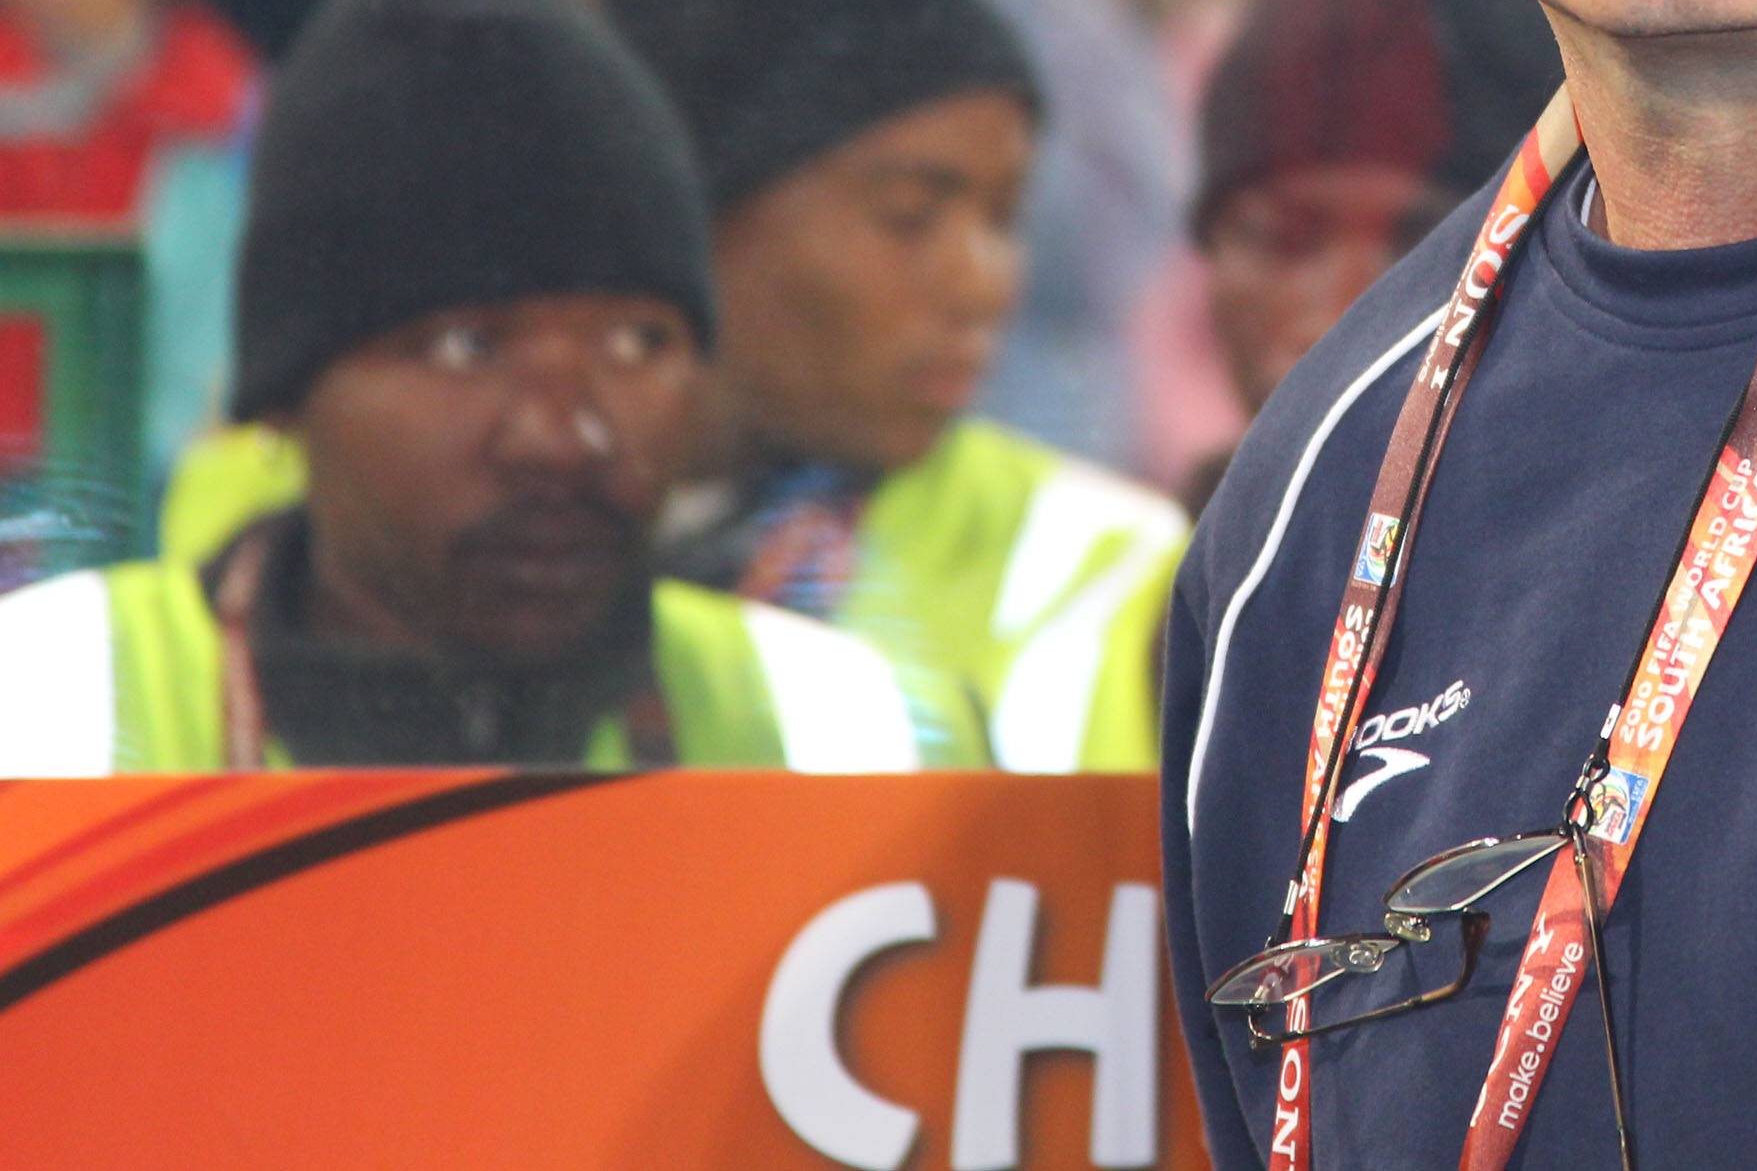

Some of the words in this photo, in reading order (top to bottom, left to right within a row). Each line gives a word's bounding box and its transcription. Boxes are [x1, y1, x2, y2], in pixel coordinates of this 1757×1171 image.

[1620, 682, 1652, 744] 2010
[1646, 618, 1677, 677] FIFA
[1676, 516, 1727, 615] WORLD
[1721, 458, 1755, 511] CUP
[1636, 613, 1712, 752] SOUTH
[1272, 998, 1306, 1171] SON
[1498, 941, 1584, 1131] make.believe
